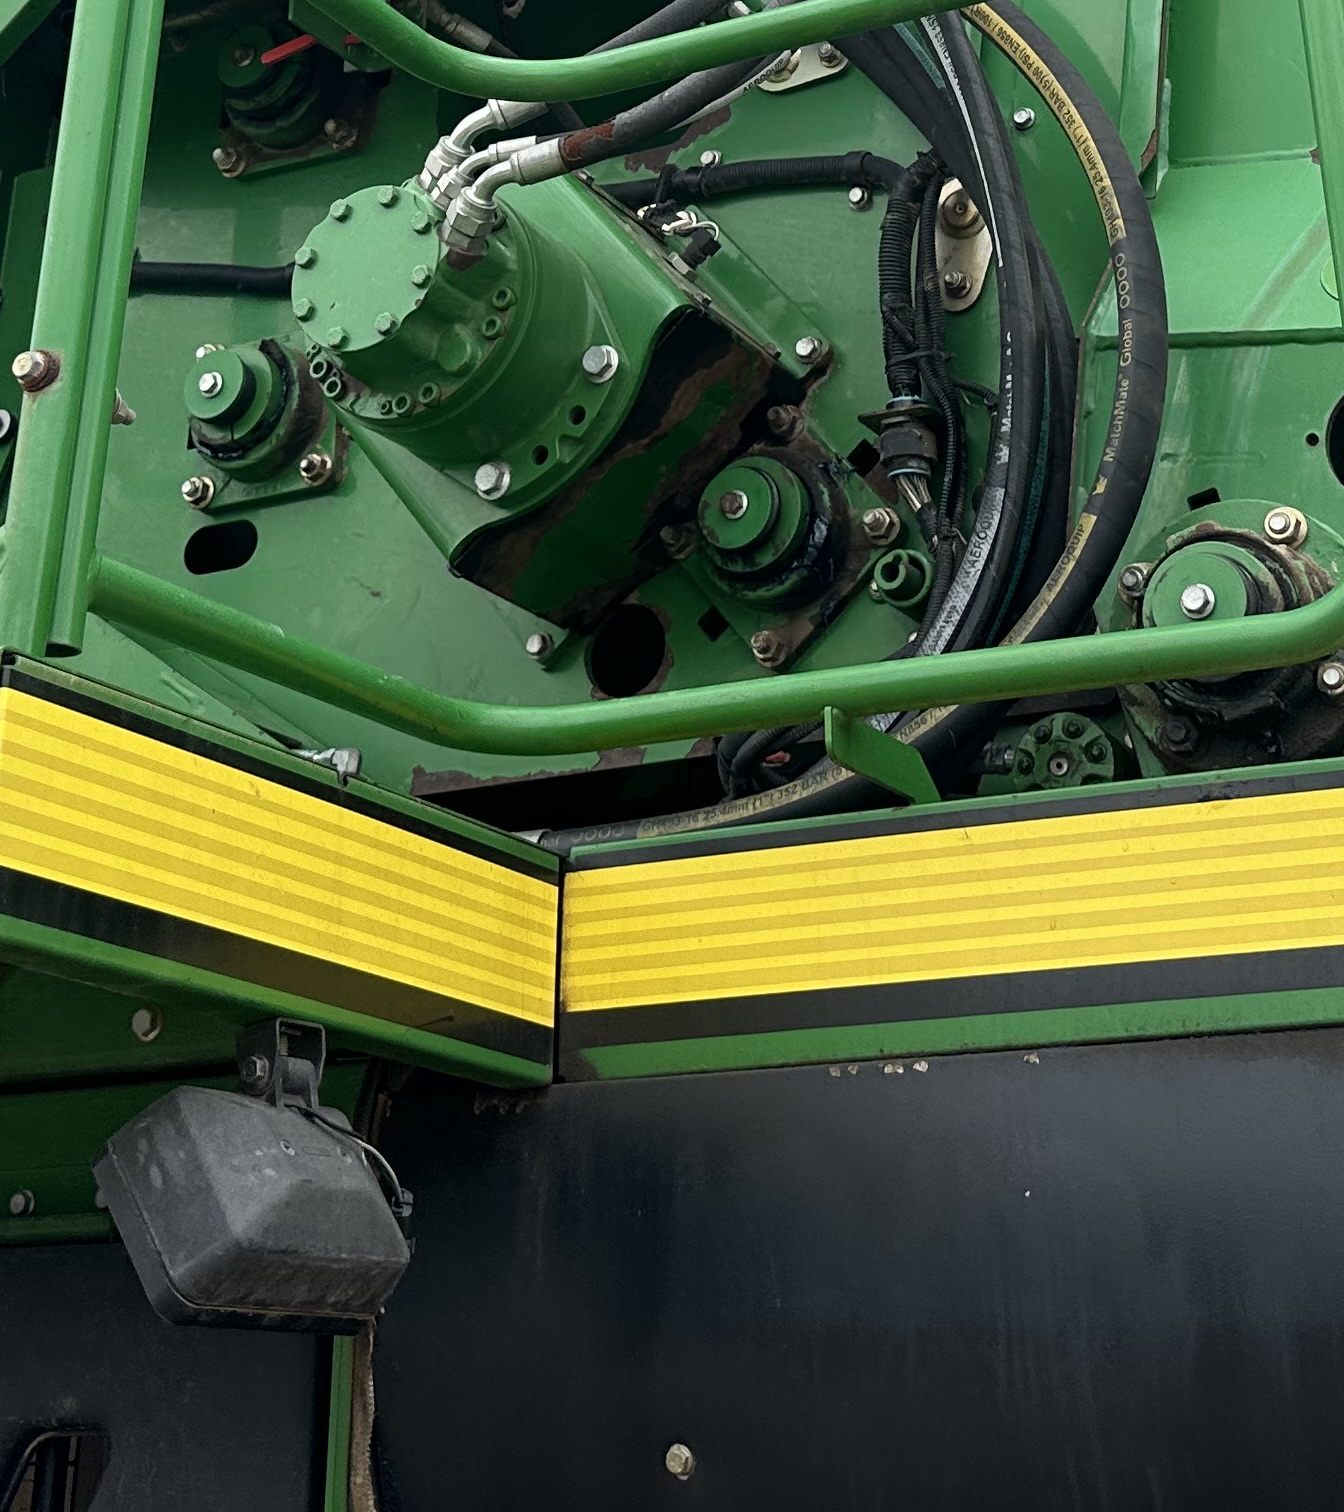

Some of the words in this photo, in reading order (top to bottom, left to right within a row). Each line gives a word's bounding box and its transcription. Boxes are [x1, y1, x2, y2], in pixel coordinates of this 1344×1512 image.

[1047, 88, 1067, 111] BAR
[1061, 108, 1077, 128] 352
[1121, 317, 1133, 366] Global
